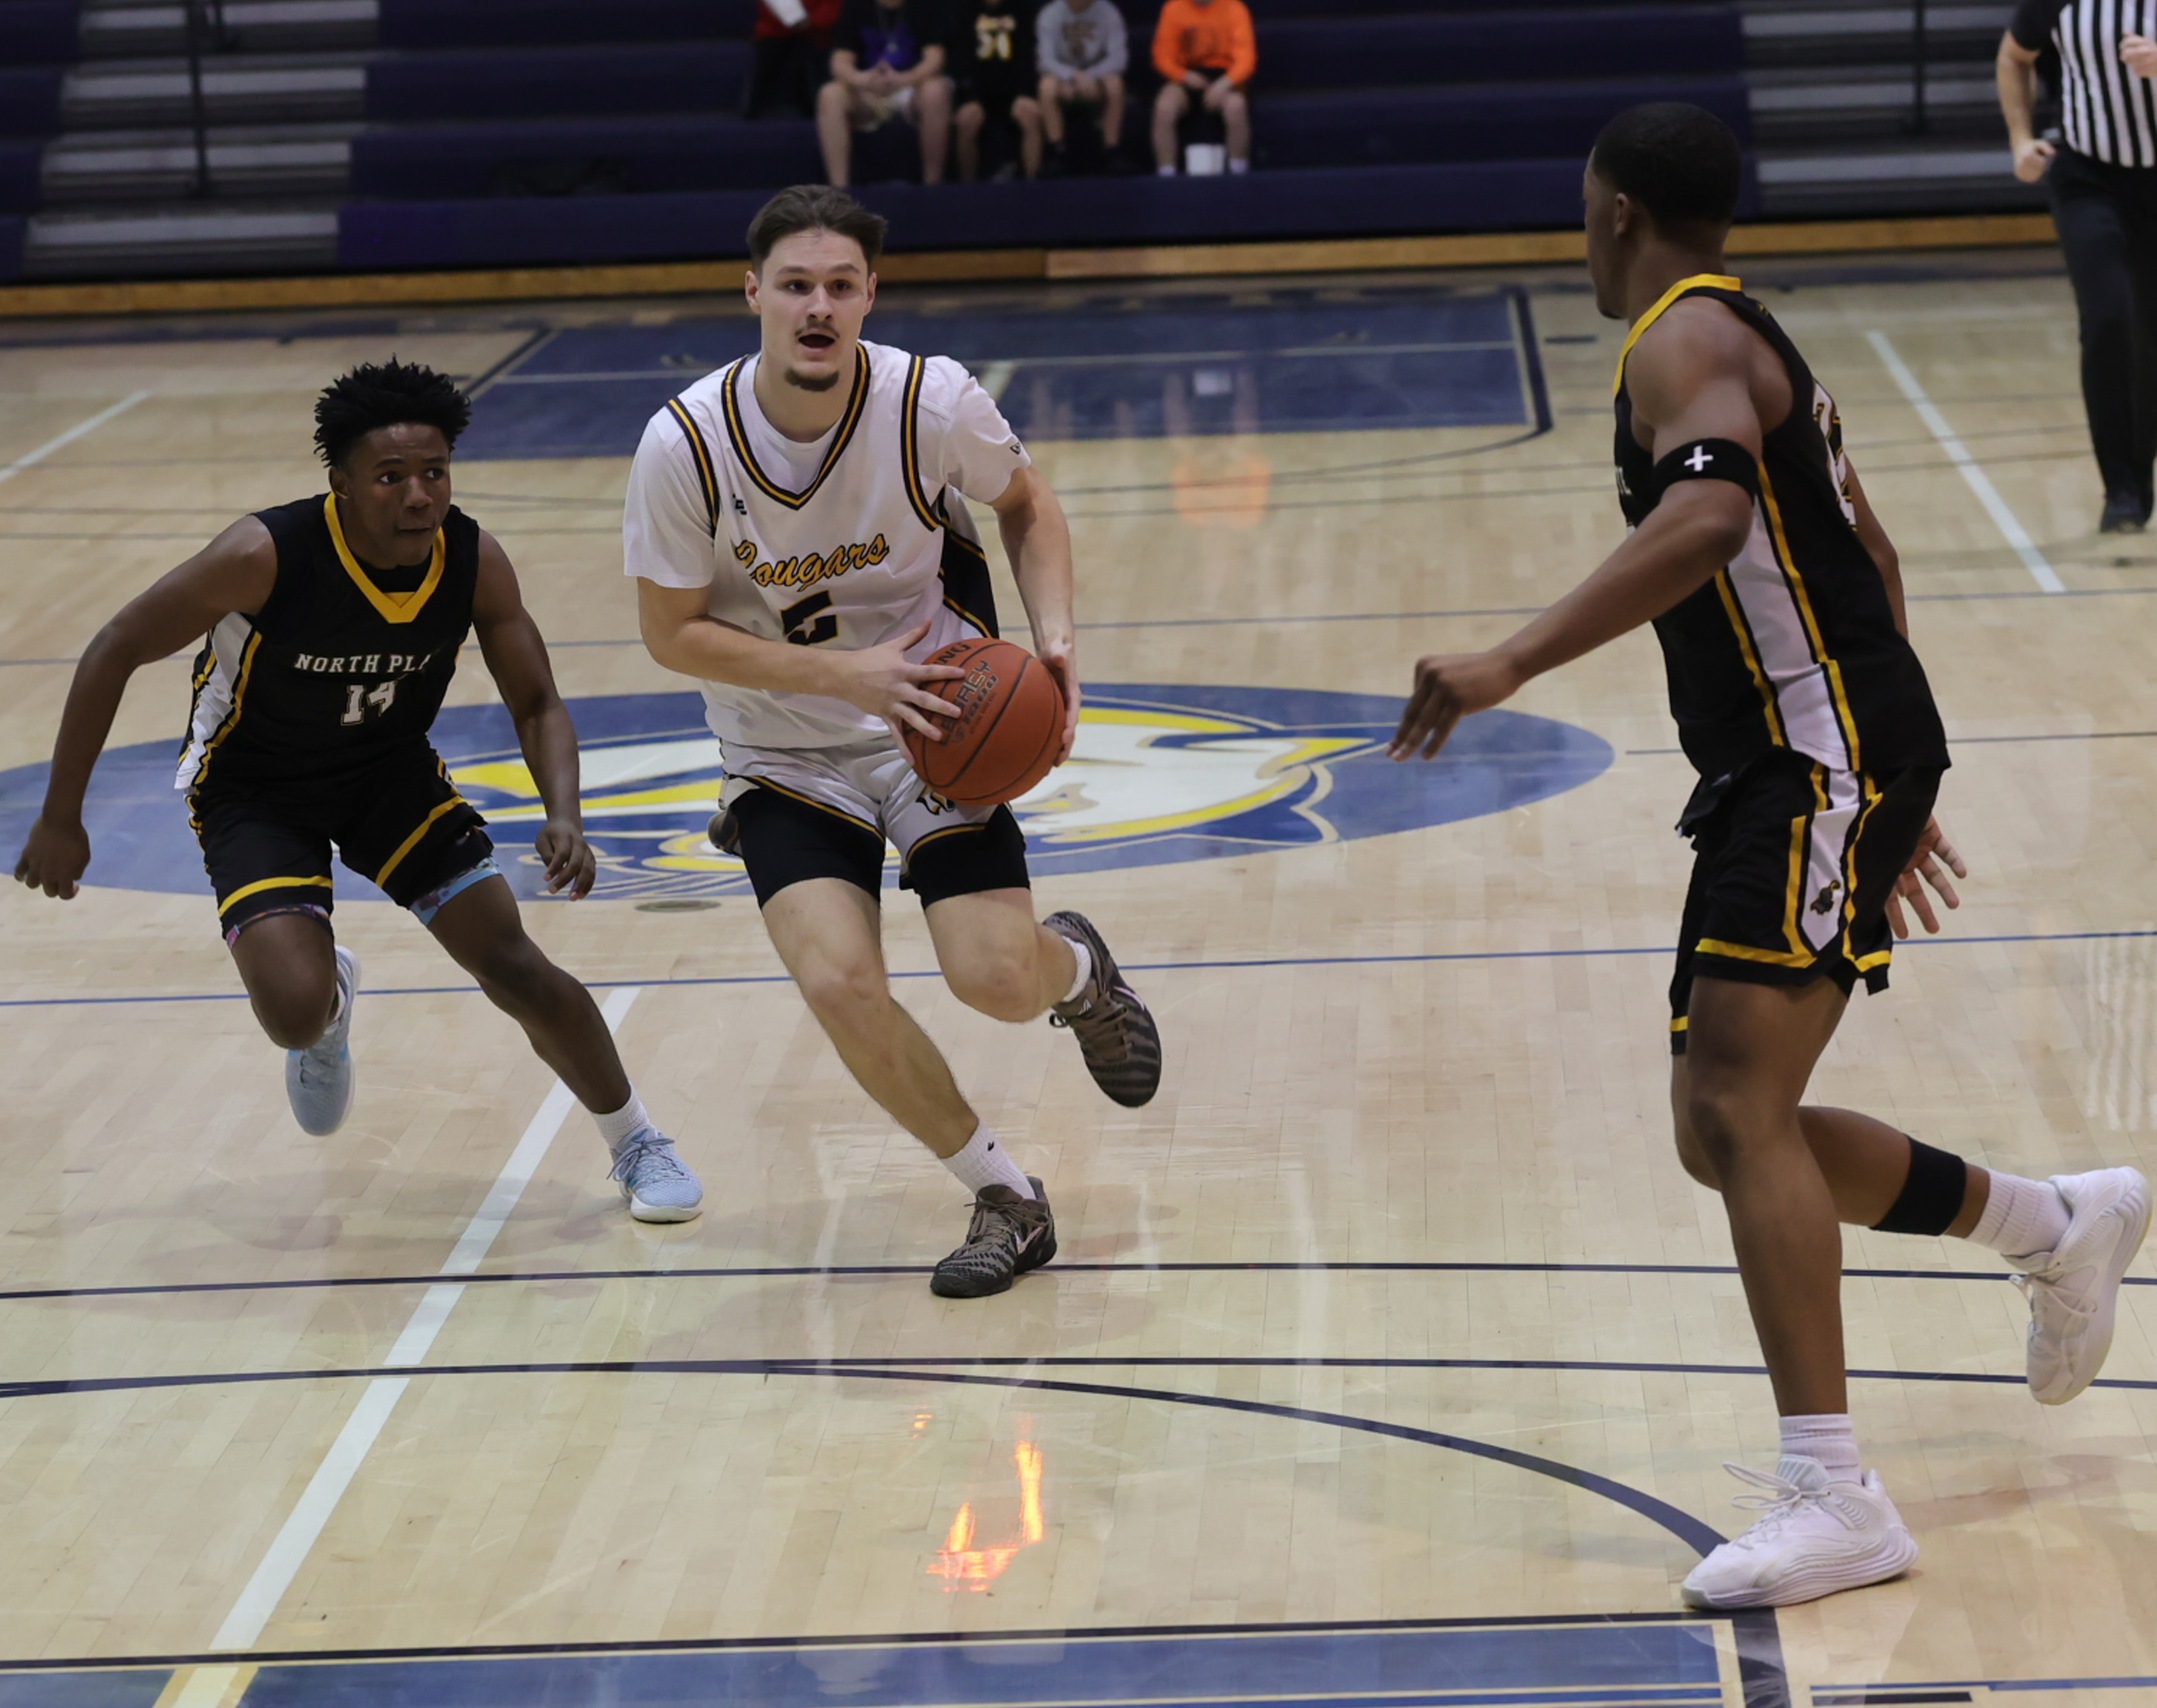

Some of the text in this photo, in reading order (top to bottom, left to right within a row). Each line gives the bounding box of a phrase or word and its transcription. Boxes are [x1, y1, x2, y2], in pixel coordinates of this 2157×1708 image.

[735, 533, 890, 592] Cougars
[294, 653, 382, 673] NORTH
[340, 680, 397, 726] 14
